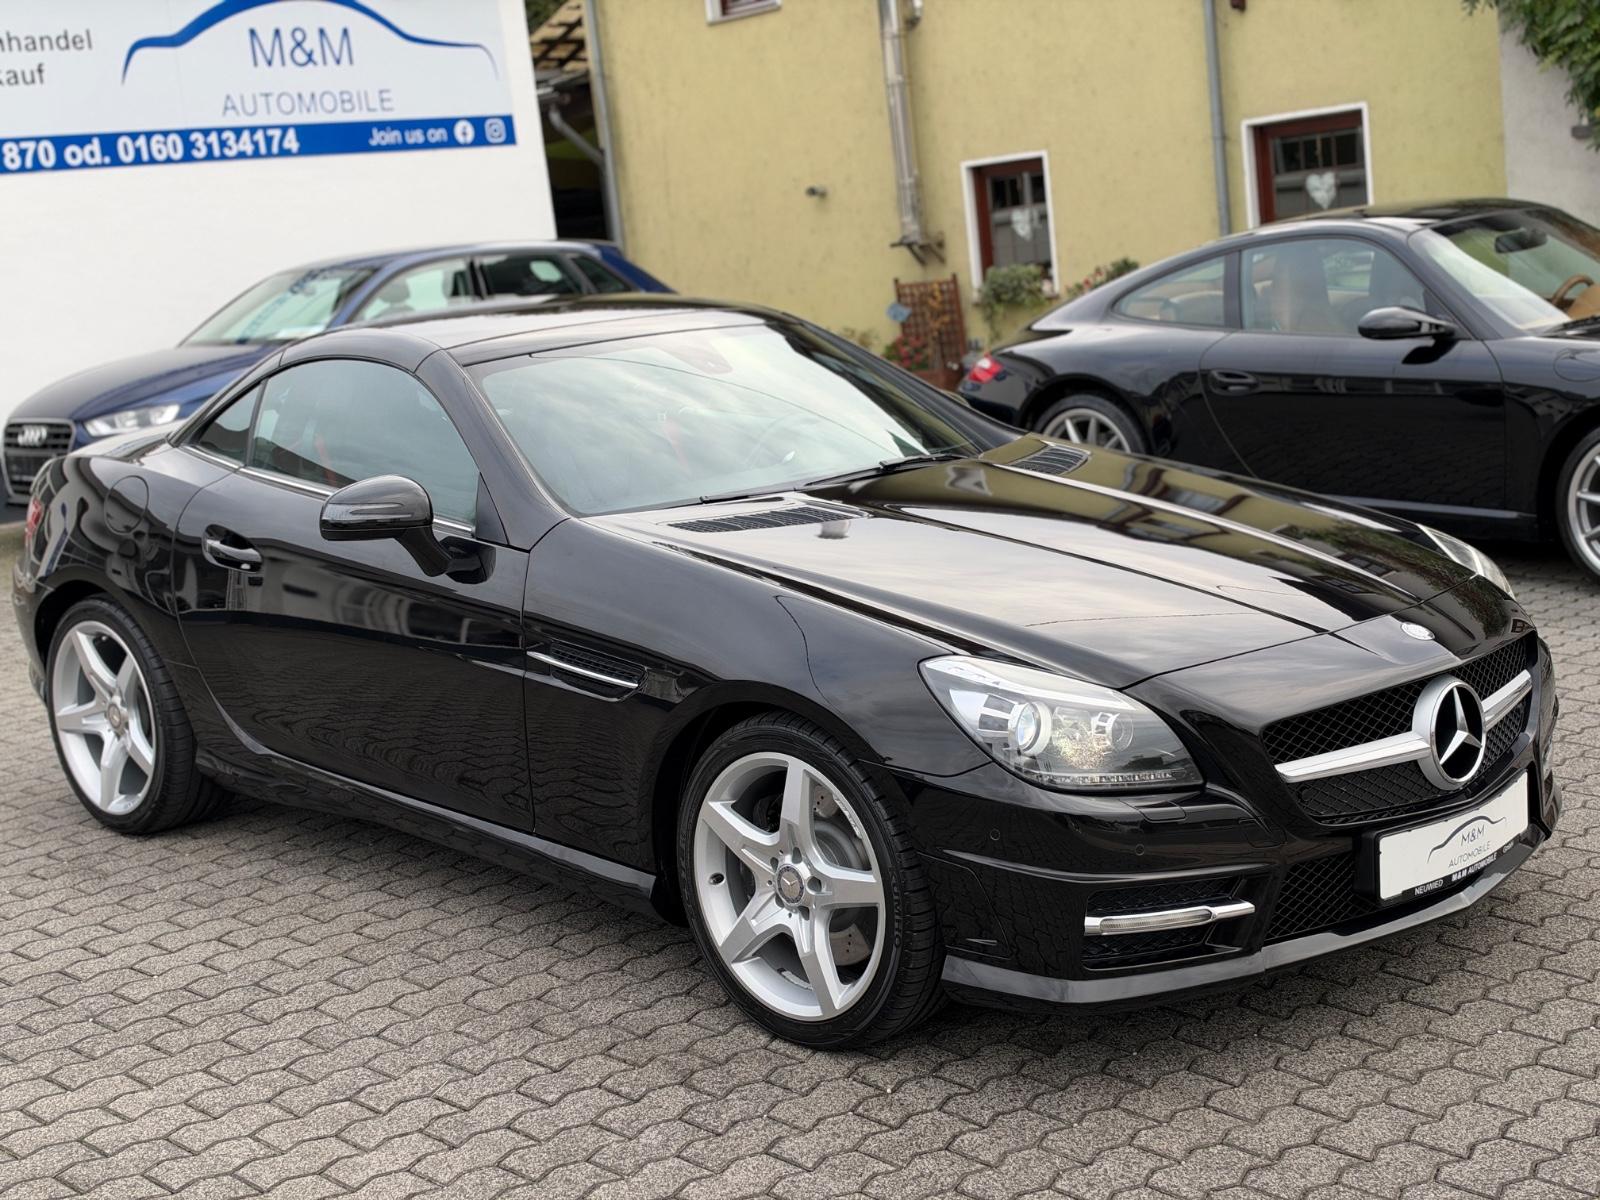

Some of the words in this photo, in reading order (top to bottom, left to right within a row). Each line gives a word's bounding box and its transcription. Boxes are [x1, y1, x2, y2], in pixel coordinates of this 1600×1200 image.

[248, 27, 354, 67] M&M
[222, 89, 394, 117] AUTOMOBILE
[2, 139, 56, 170] 870
[63, 136, 111, 167] od.
[117, 133, 184, 163] 0160
[189, 127, 300, 159] 3134174
[368, 126, 402, 146] Join
[404, 128, 425, 144] us
[426, 127, 448, 143] on
[1460, 825, 1485, 846] M&M
[1448, 840, 1491, 868] AUTOMOBILE
[1414, 879, 1444, 896] NEUWIED
[1468, 852, 1498, 874] AUTOMOBILE
